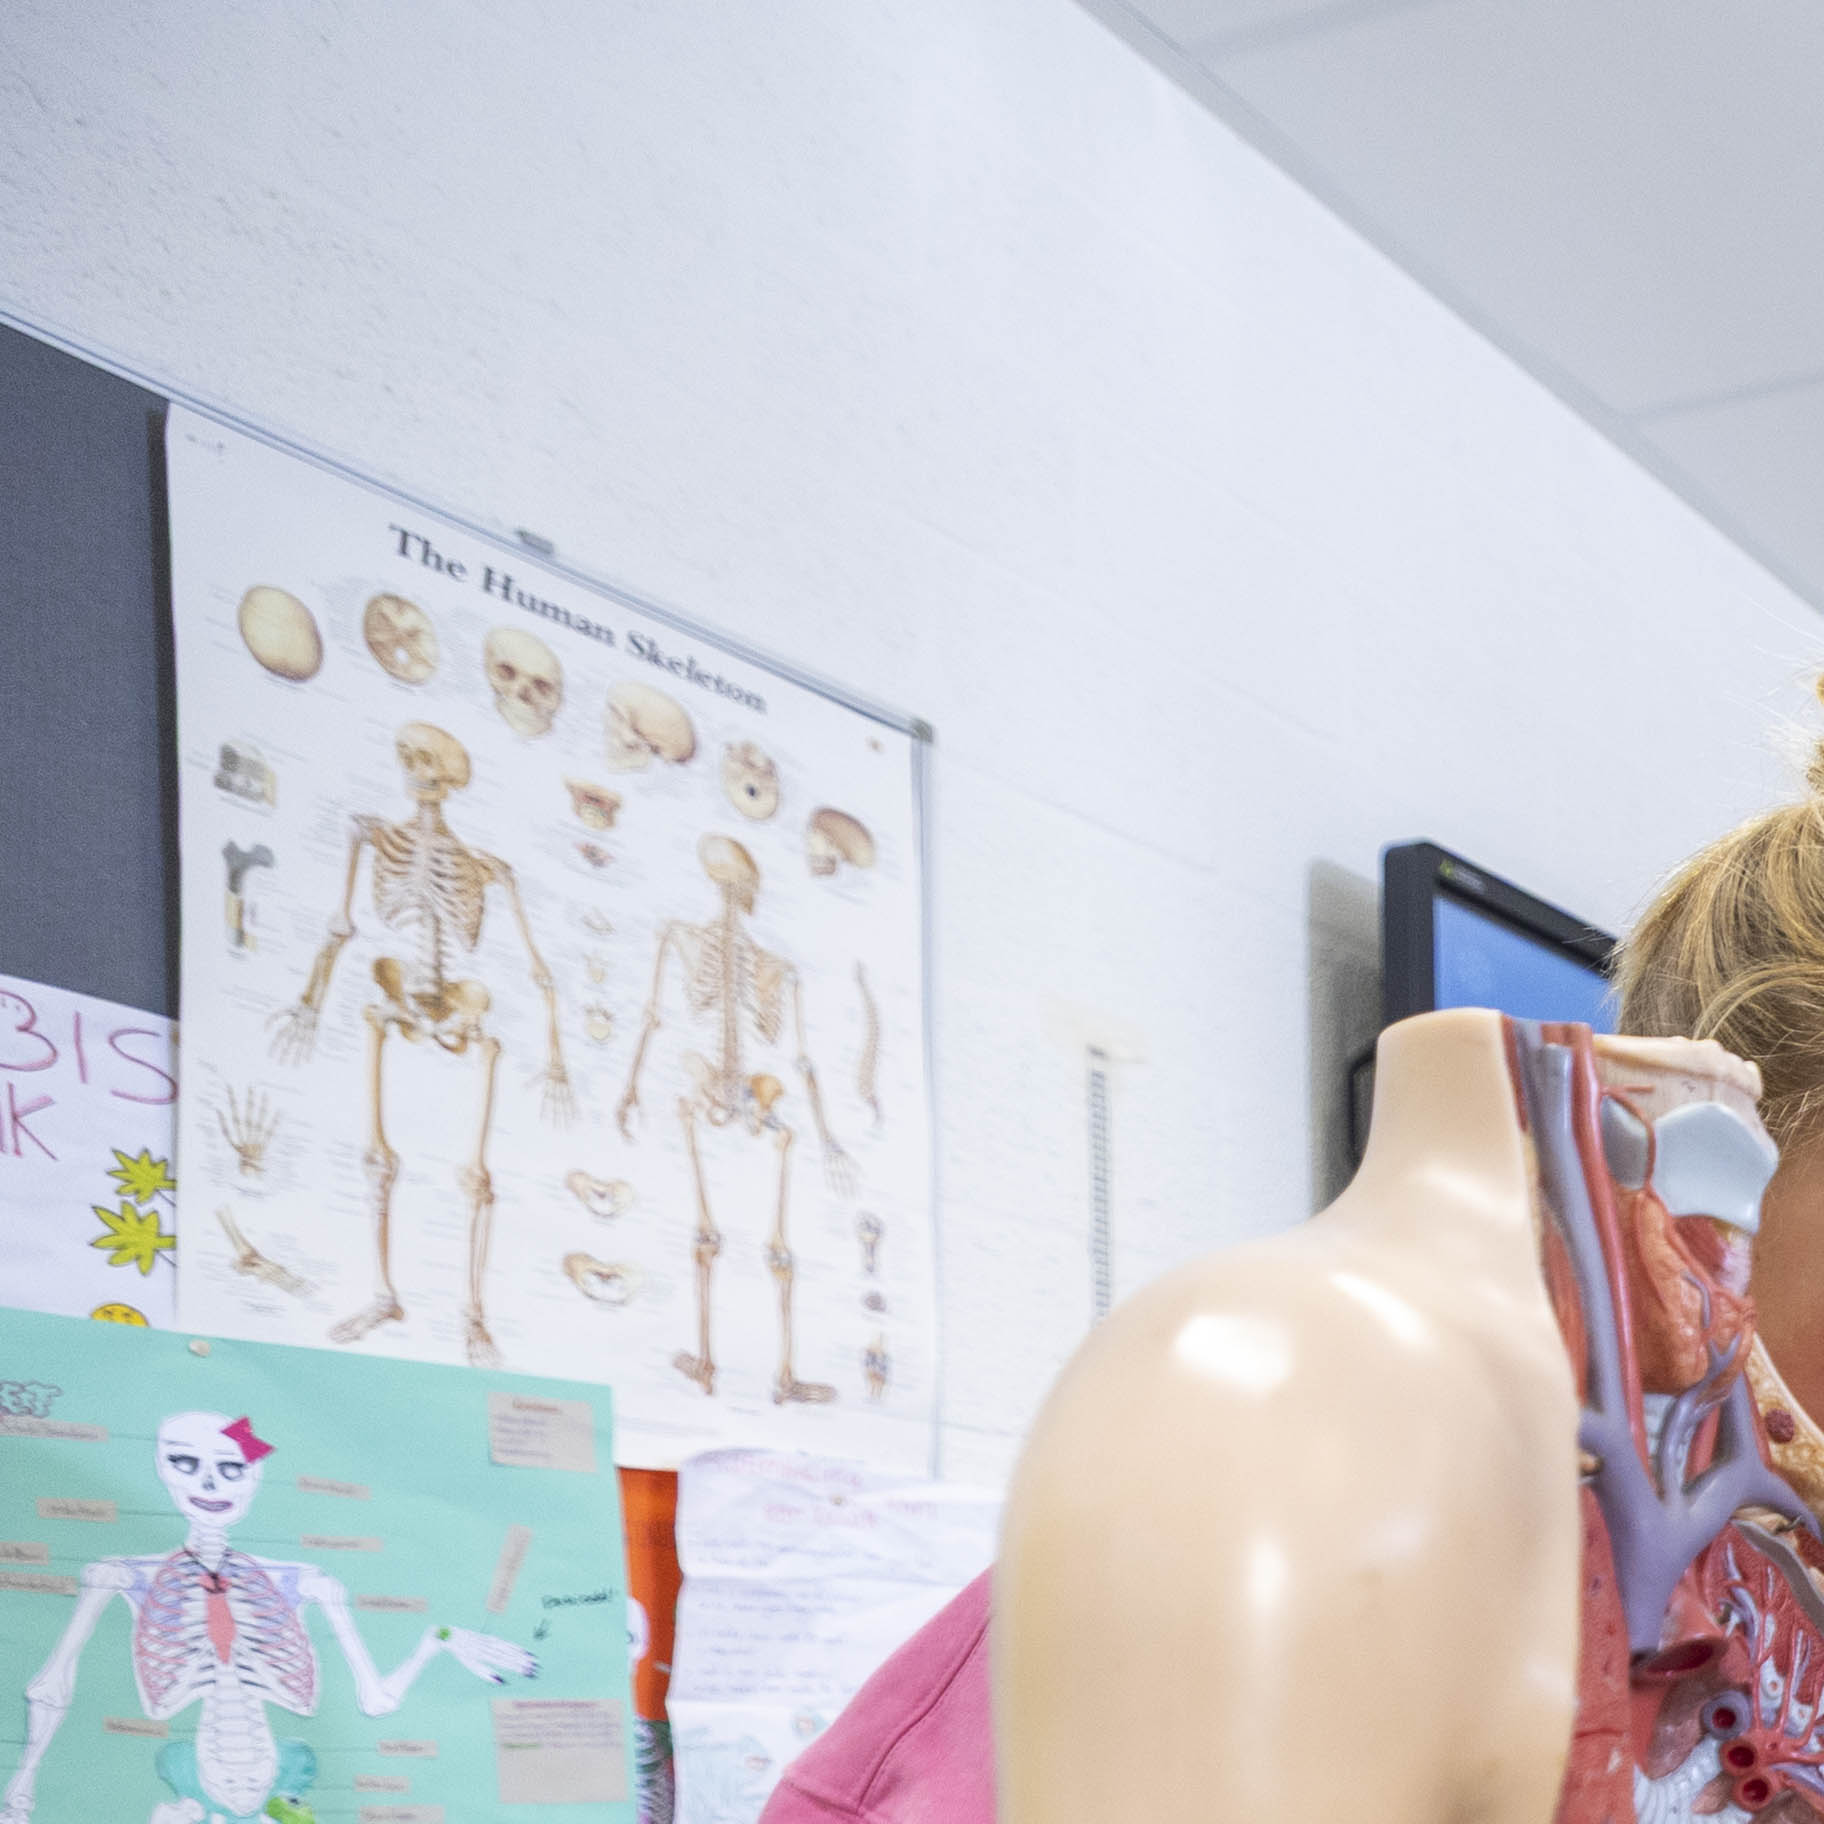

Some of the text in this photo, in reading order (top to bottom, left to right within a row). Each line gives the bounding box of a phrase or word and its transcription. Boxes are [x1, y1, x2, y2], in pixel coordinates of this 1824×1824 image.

[388, 523, 768, 714] The Human Skeleton
